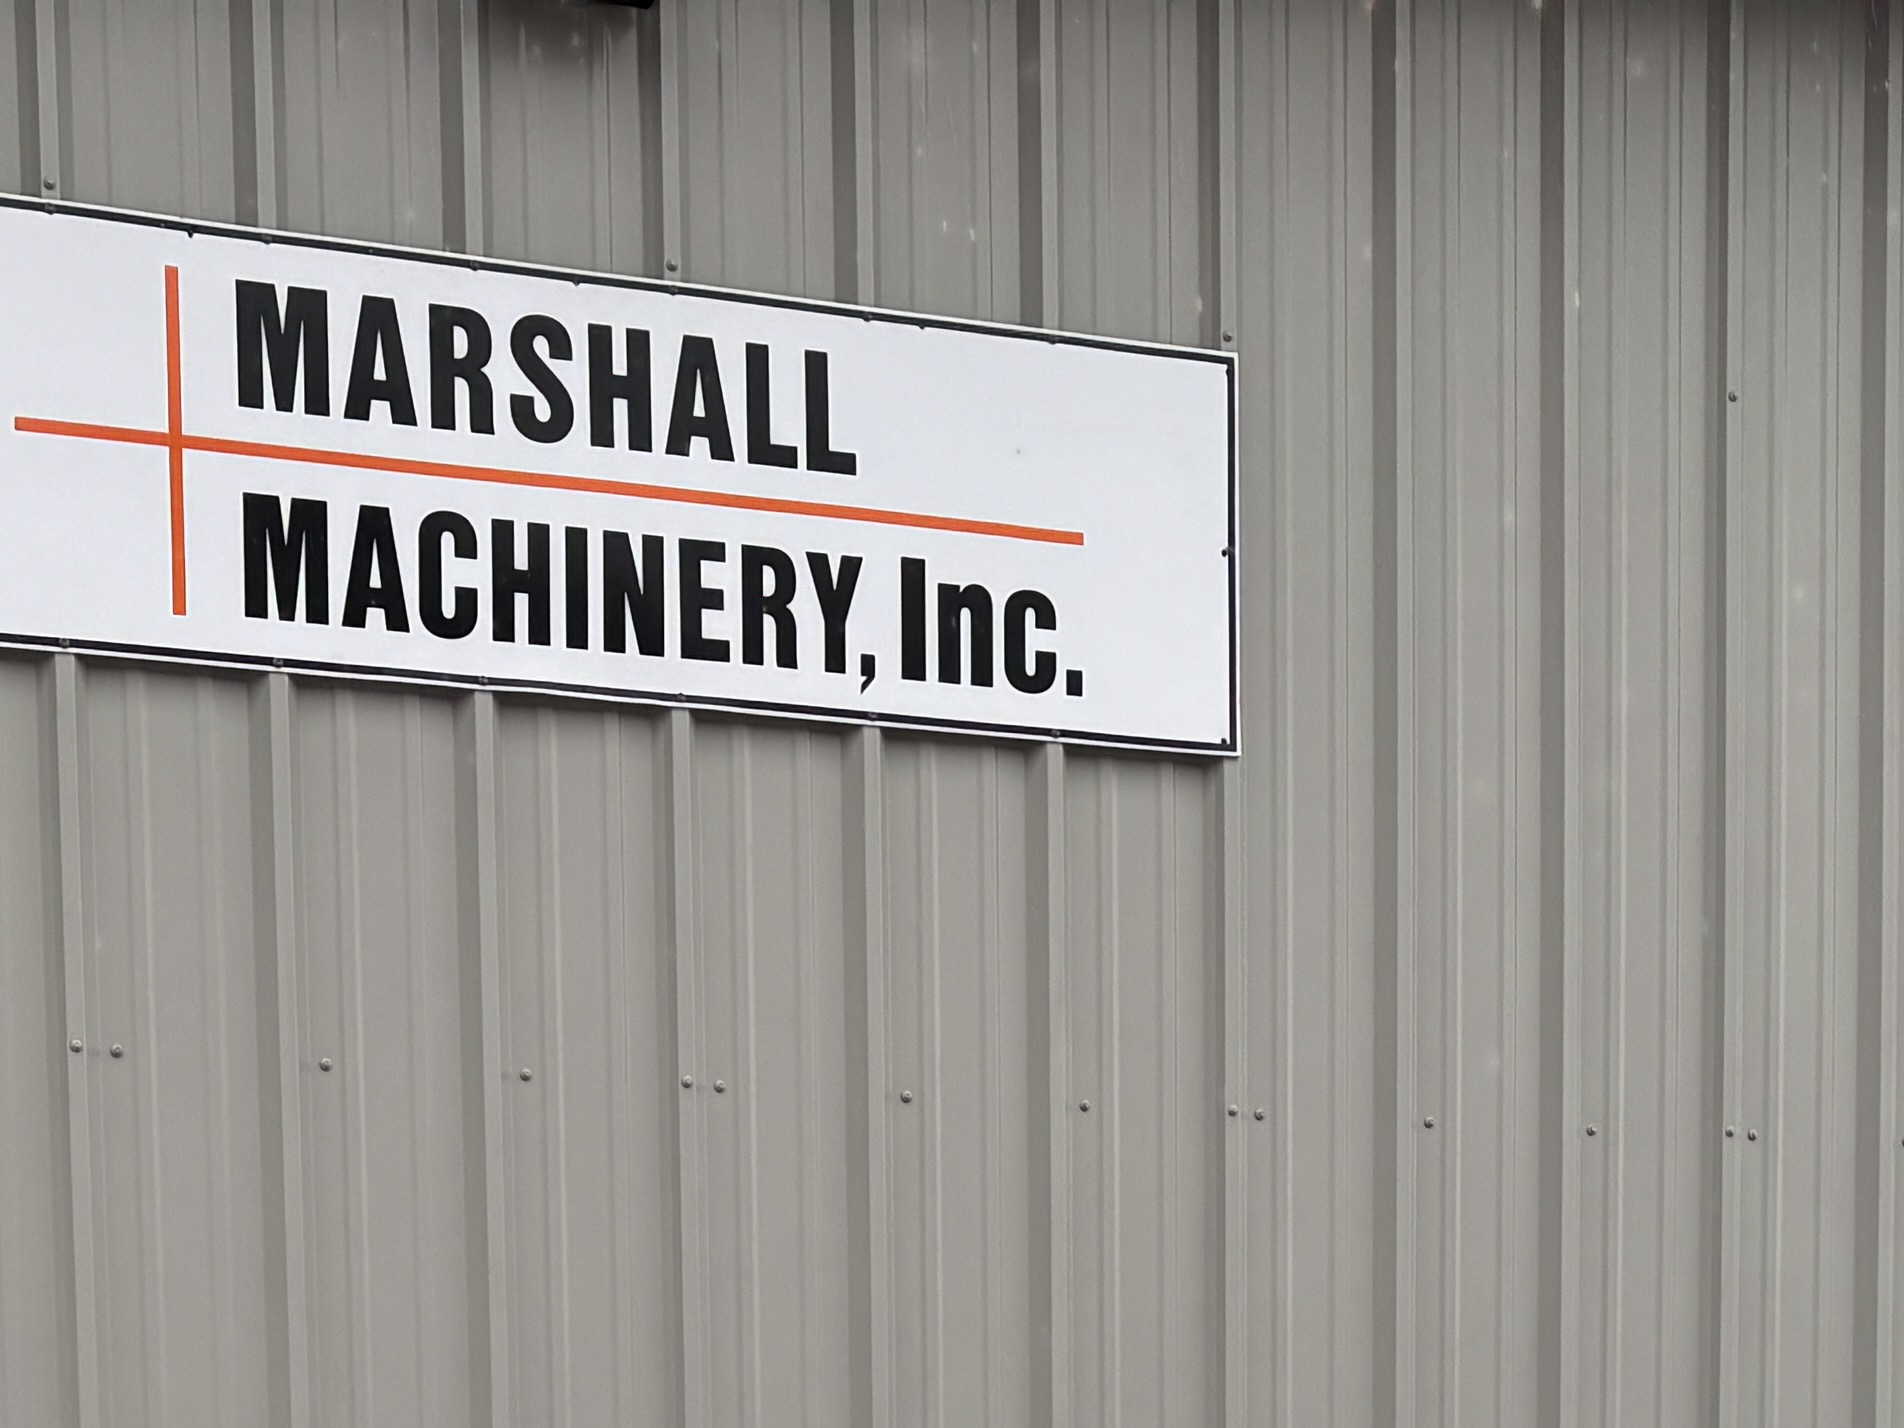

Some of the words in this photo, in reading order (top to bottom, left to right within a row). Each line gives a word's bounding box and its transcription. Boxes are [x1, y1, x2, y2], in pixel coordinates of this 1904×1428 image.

[234, 279, 857, 475] MARSHALL
[241, 492, 876, 693] MACHINERY,
[899, 556, 1084, 697] Inc.
